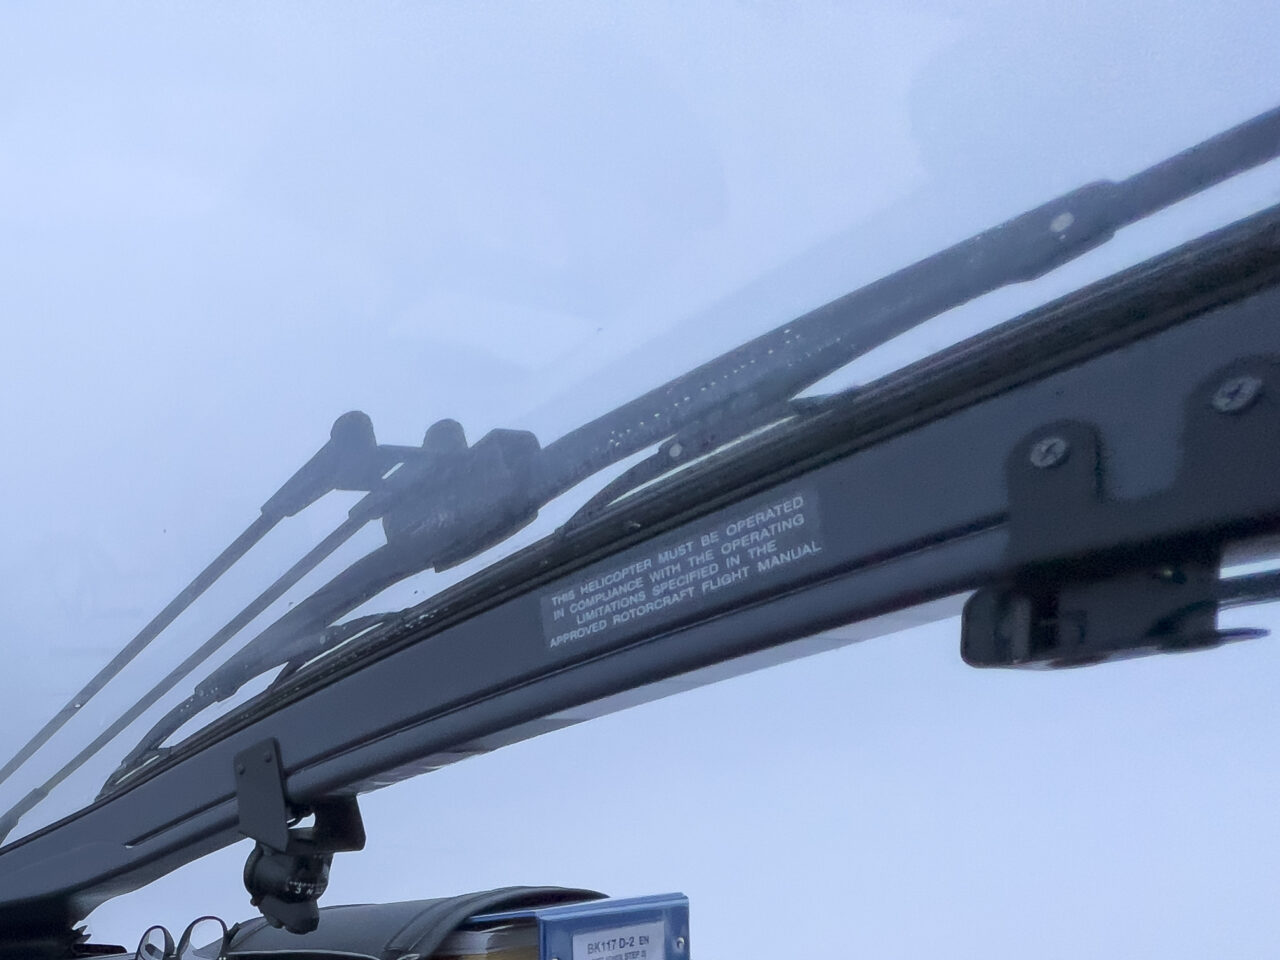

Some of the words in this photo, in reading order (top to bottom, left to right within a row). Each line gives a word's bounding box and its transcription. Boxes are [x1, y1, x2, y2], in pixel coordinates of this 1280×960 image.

[549, 620, 608, 648] APPROVED
[612, 587, 695, 625] ROTORCRAFT
[702, 566, 749, 593] FLIGHT
[757, 540, 822, 572] MANUAL
[551, 589, 575, 607] THIS
[581, 559, 652, 595] HELICOPTER
[658, 541, 694, 564] MUST
[701, 531, 719, 547] BE
[726, 496, 804, 536] OPERATED
[553, 608, 565, 621] IN
[569, 577, 644, 614] COMPLIANCE
[649, 562, 681, 582] WITH
[688, 550, 715, 568] THE
[720, 513, 805, 555] OPERATING
[576, 591, 646, 625] LIMITATIONS
[652, 563, 719, 596] SPECIFIED
[726, 552, 741, 568] IN
[747, 539, 778, 559] THE
[587, 939, 616, 954] BK117
[618, 936, 635, 949] D-2
[638, 936, 650, 946] EN
